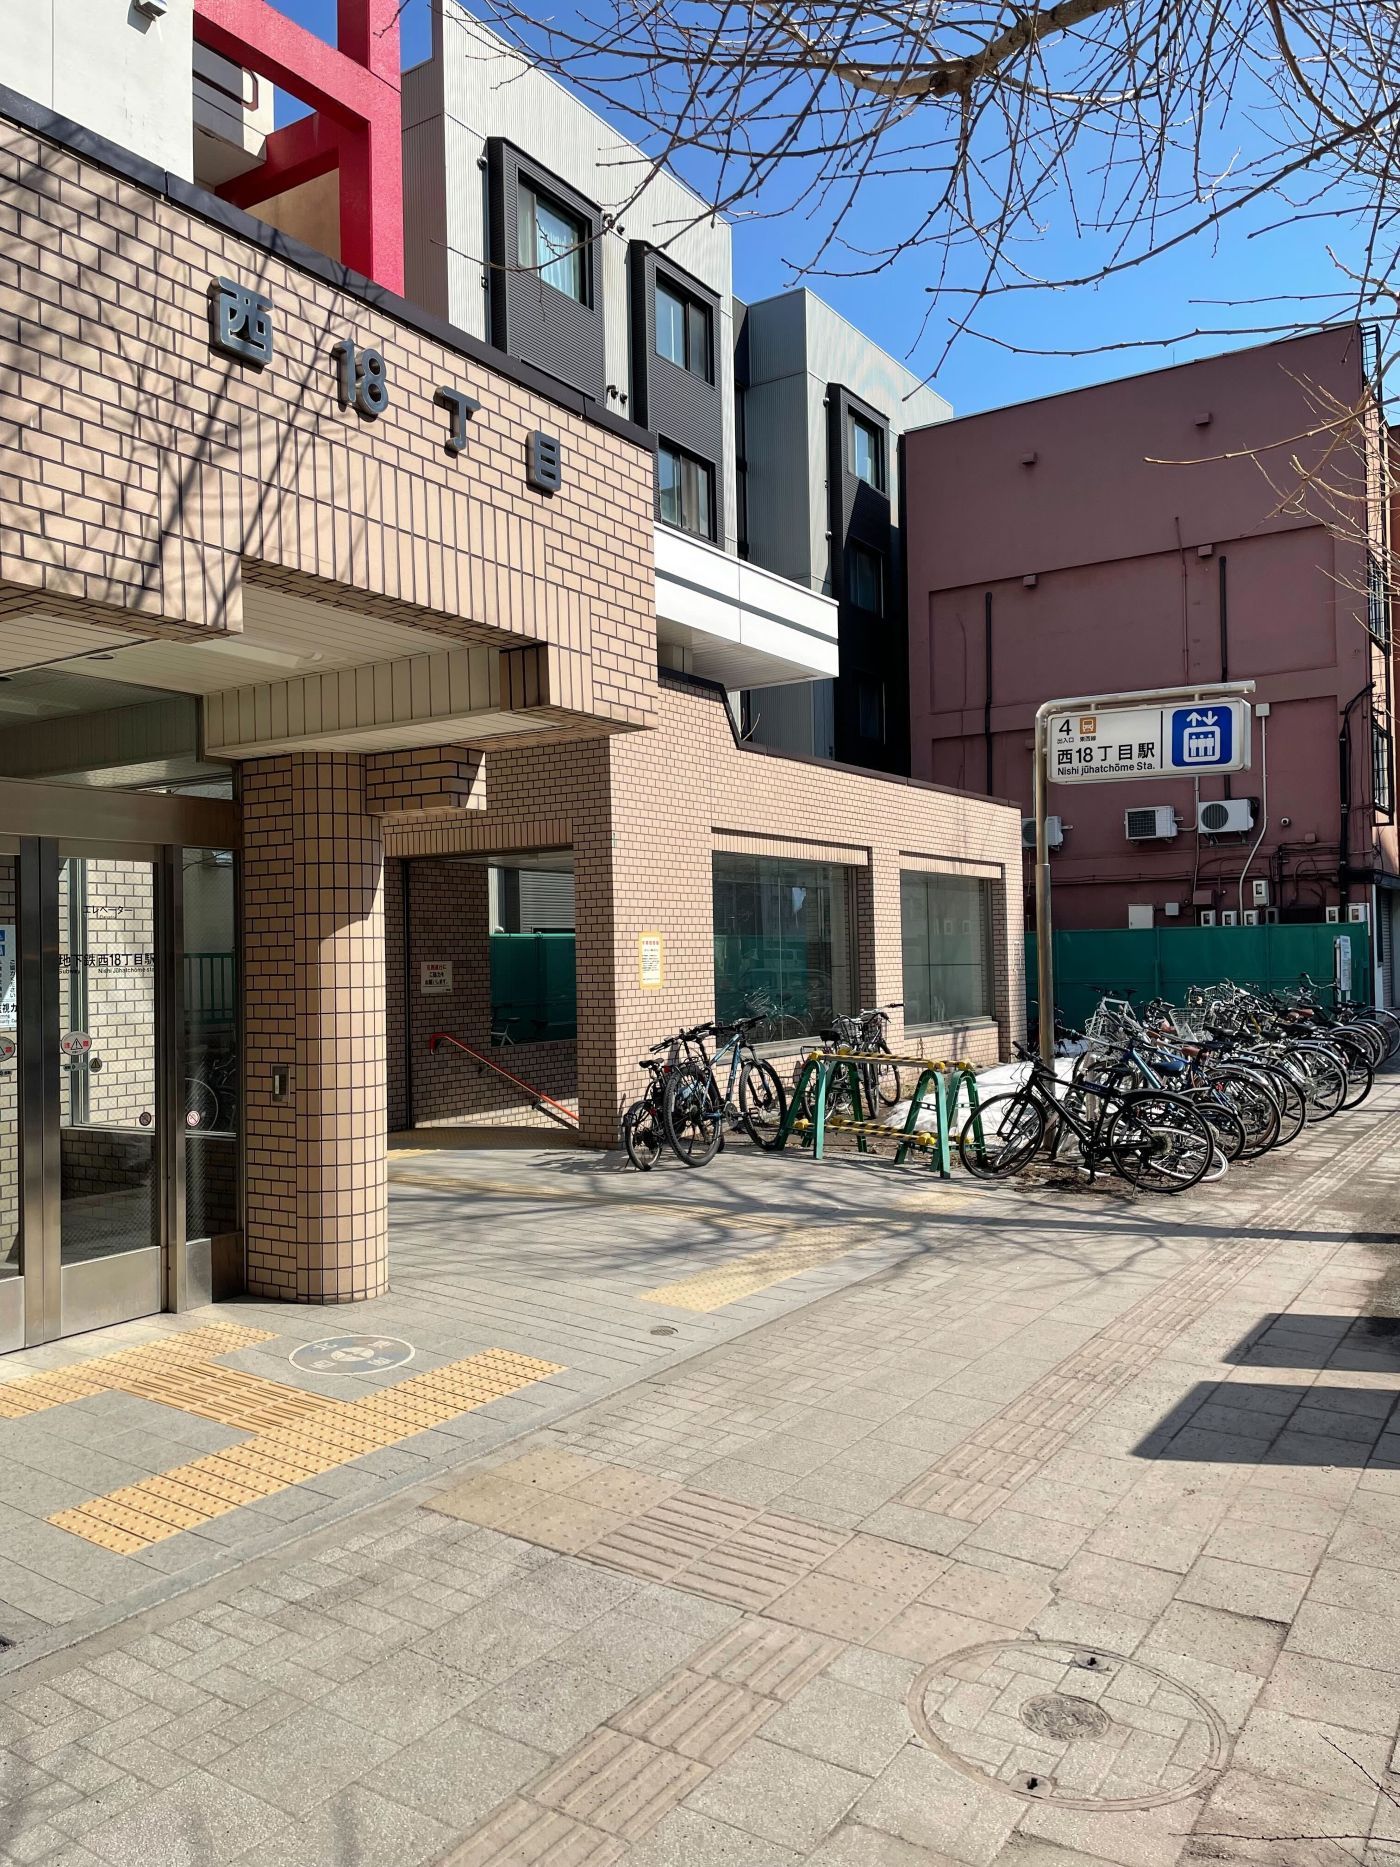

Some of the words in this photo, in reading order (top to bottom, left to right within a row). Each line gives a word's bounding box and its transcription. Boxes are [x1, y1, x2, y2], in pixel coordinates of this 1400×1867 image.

[207, 276, 561, 494] 西18丁目
[1058, 718, 1072, 736] 4
[1057, 736, 1075, 744] 出入口
[1057, 742, 1156, 765] 西18丁目駅
[1057, 765, 1080, 776] Nishi
[1136, 761, 1156, 771] Sta.
